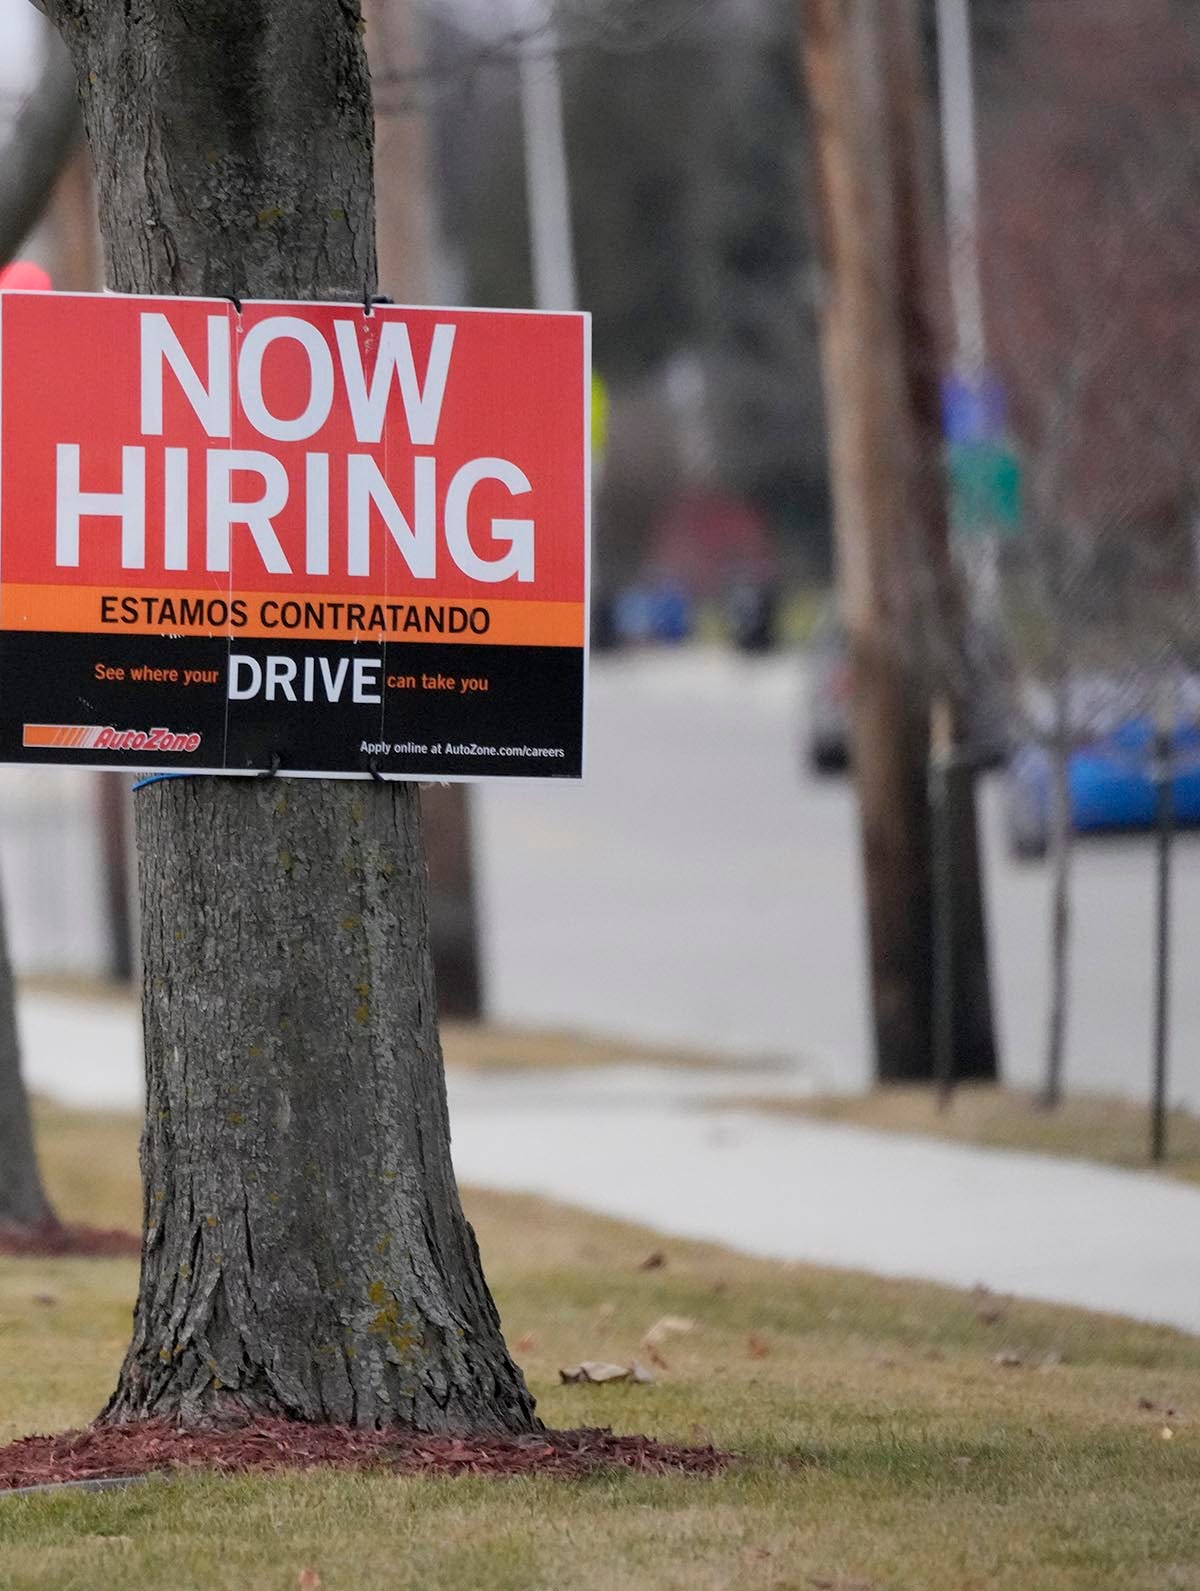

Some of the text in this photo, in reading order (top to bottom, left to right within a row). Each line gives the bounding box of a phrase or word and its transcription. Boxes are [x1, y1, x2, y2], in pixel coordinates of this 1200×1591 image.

[140, 312, 456, 445] NOW
[55, 443, 535, 582] HIRING
[101, 596, 490, 635] ESTAMOS CONTRATANDO
[95, 654, 489, 704] See where your DRIVE can take you
[93, 726, 201, 752] AutoZone
[360, 740, 565, 758] Apply online at AutoZone.com/careers
